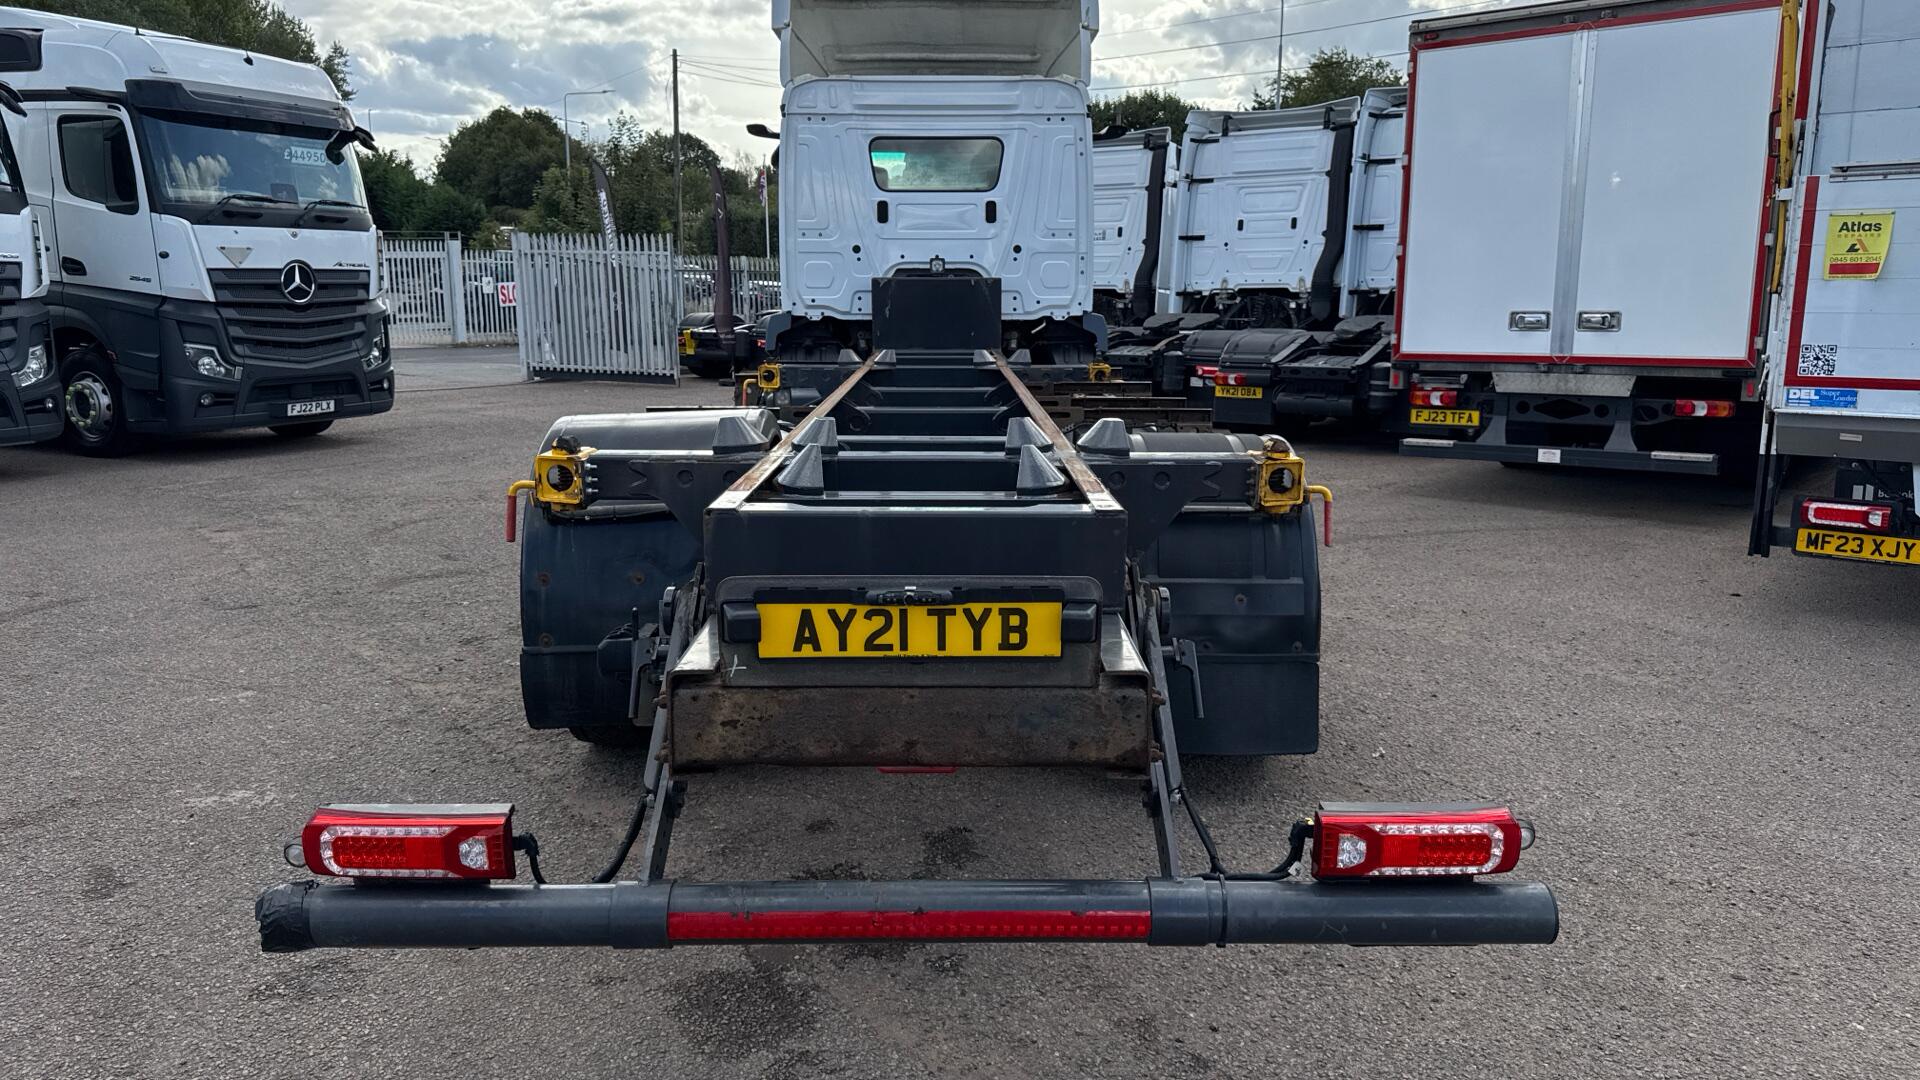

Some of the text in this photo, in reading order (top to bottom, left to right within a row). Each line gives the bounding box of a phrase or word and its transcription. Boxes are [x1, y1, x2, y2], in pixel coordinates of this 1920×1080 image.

[1838, 221, 1883, 232] Atlas
[1220, 386, 1239, 396] YK21
[1789, 389, 1819, 399] DEL
[1833, 394, 1857, 402] Loader
[290, 401, 331, 414] FJ22 PLX
[1415, 410, 1473, 424] FJ23 TFA
[1806, 531, 1917, 560] MF23 XJY
[792, 607, 1029, 652] AY21 TYB
